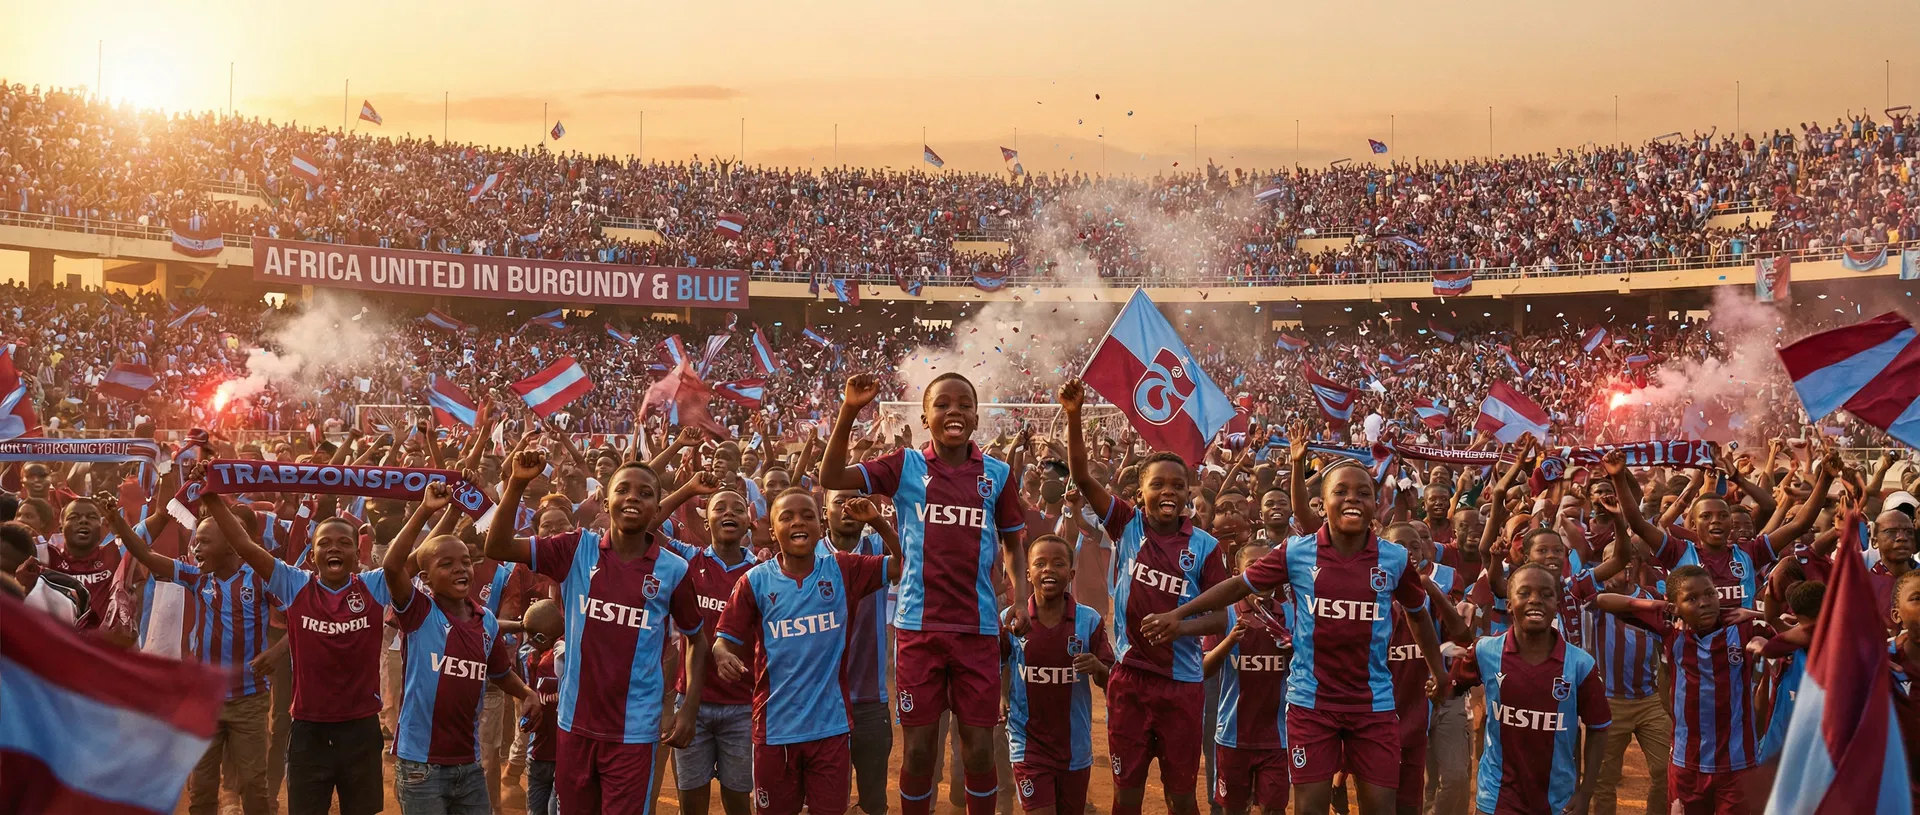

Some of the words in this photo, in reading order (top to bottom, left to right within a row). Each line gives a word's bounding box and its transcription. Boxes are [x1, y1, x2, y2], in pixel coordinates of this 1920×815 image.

[264, 246, 362, 282] AFRICA
[370, 256, 465, 289] UNITED
[473, 264, 499, 292] IN
[507, 265, 644, 299] BURGUNDY
[652, 273, 669, 300] &
[677, 274, 740, 302] BLUE
[915, 502, 987, 529] VESTEL
[1127, 558, 1191, 598] VESTEL
[1716, 584, 1749, 600] STEL
[579, 594, 652, 631] VESTEL
[1304, 594, 1384, 621] VESTEL
[768, 611, 840, 639] VESTEL
[1230, 653, 1285, 671] VESTE
[1388, 643, 1424, 661] ESTE
[1492, 700, 1568, 731] VESTEL
